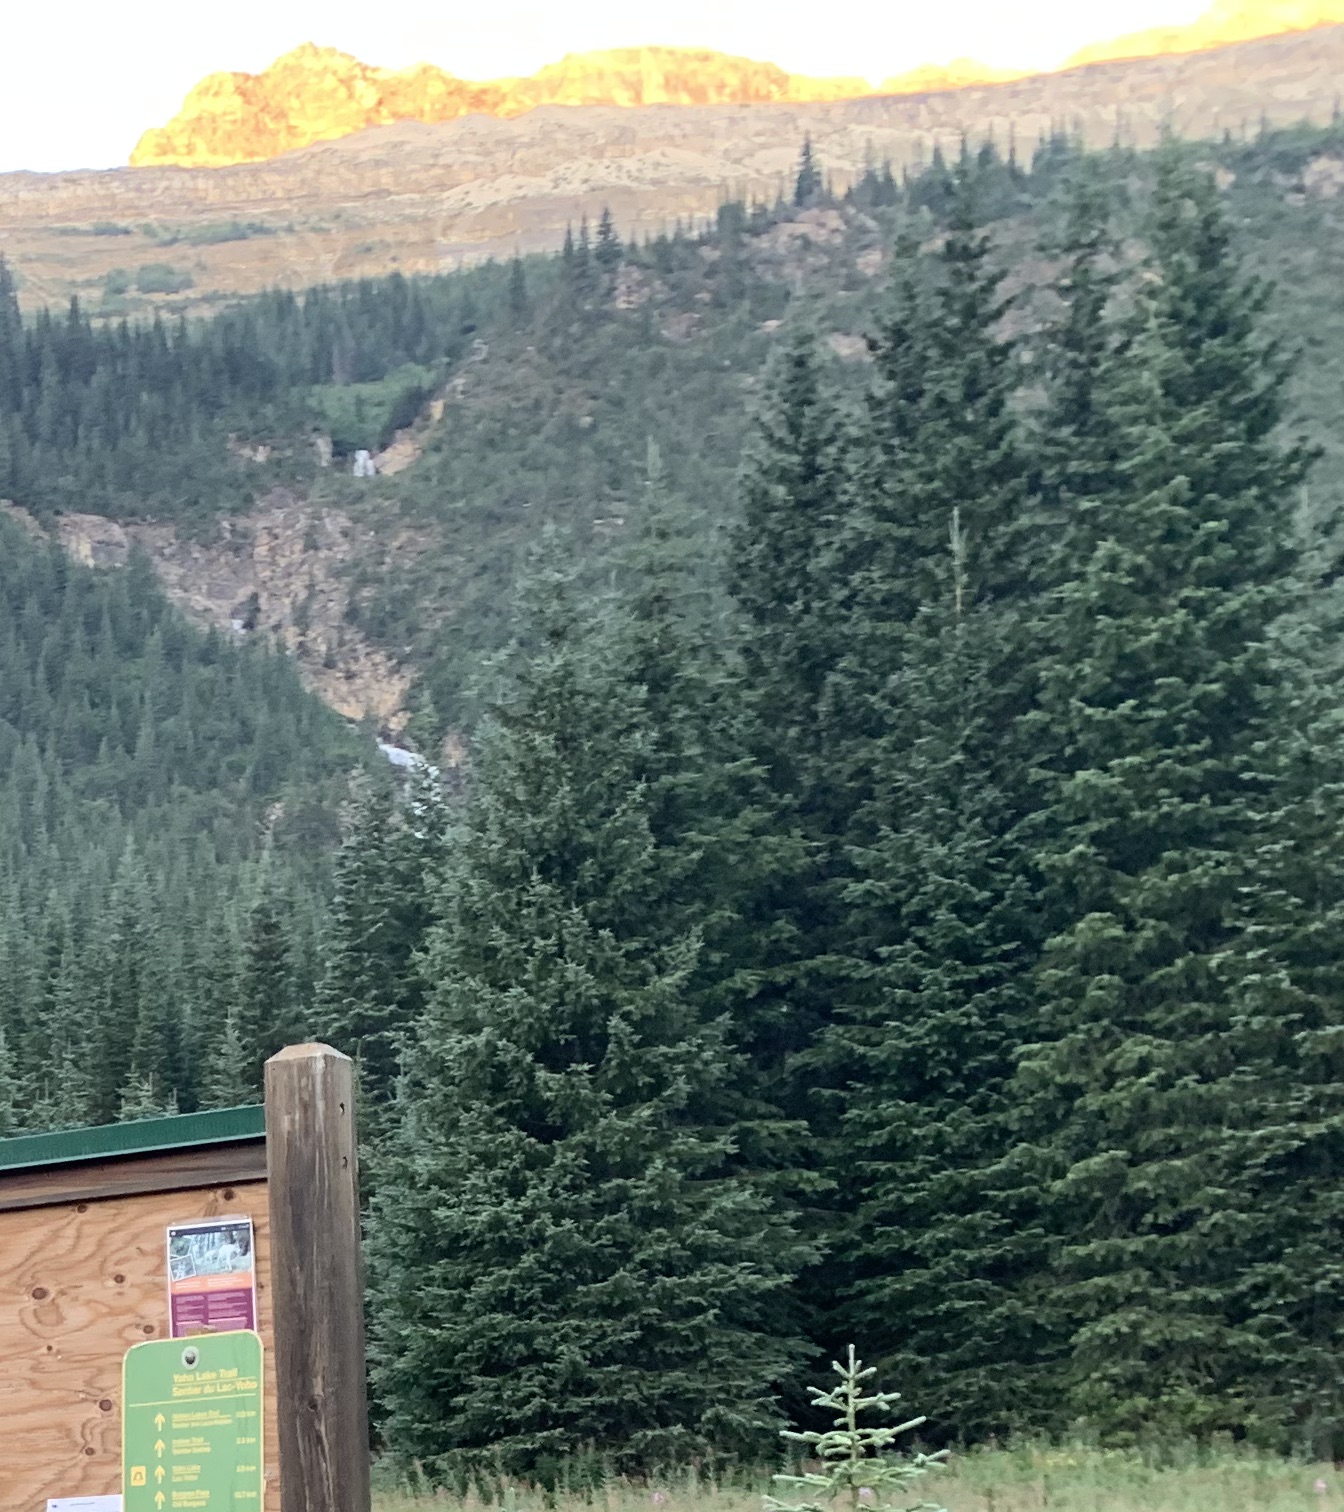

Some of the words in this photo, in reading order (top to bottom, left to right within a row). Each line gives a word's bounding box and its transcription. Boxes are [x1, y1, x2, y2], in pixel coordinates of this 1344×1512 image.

[173, 1374, 194, 1383] Yoho
[196, 1371, 217, 1381] Lake
[219, 1368, 238, 1378] Trail
[172, 1386, 202, 1396] Sentier
